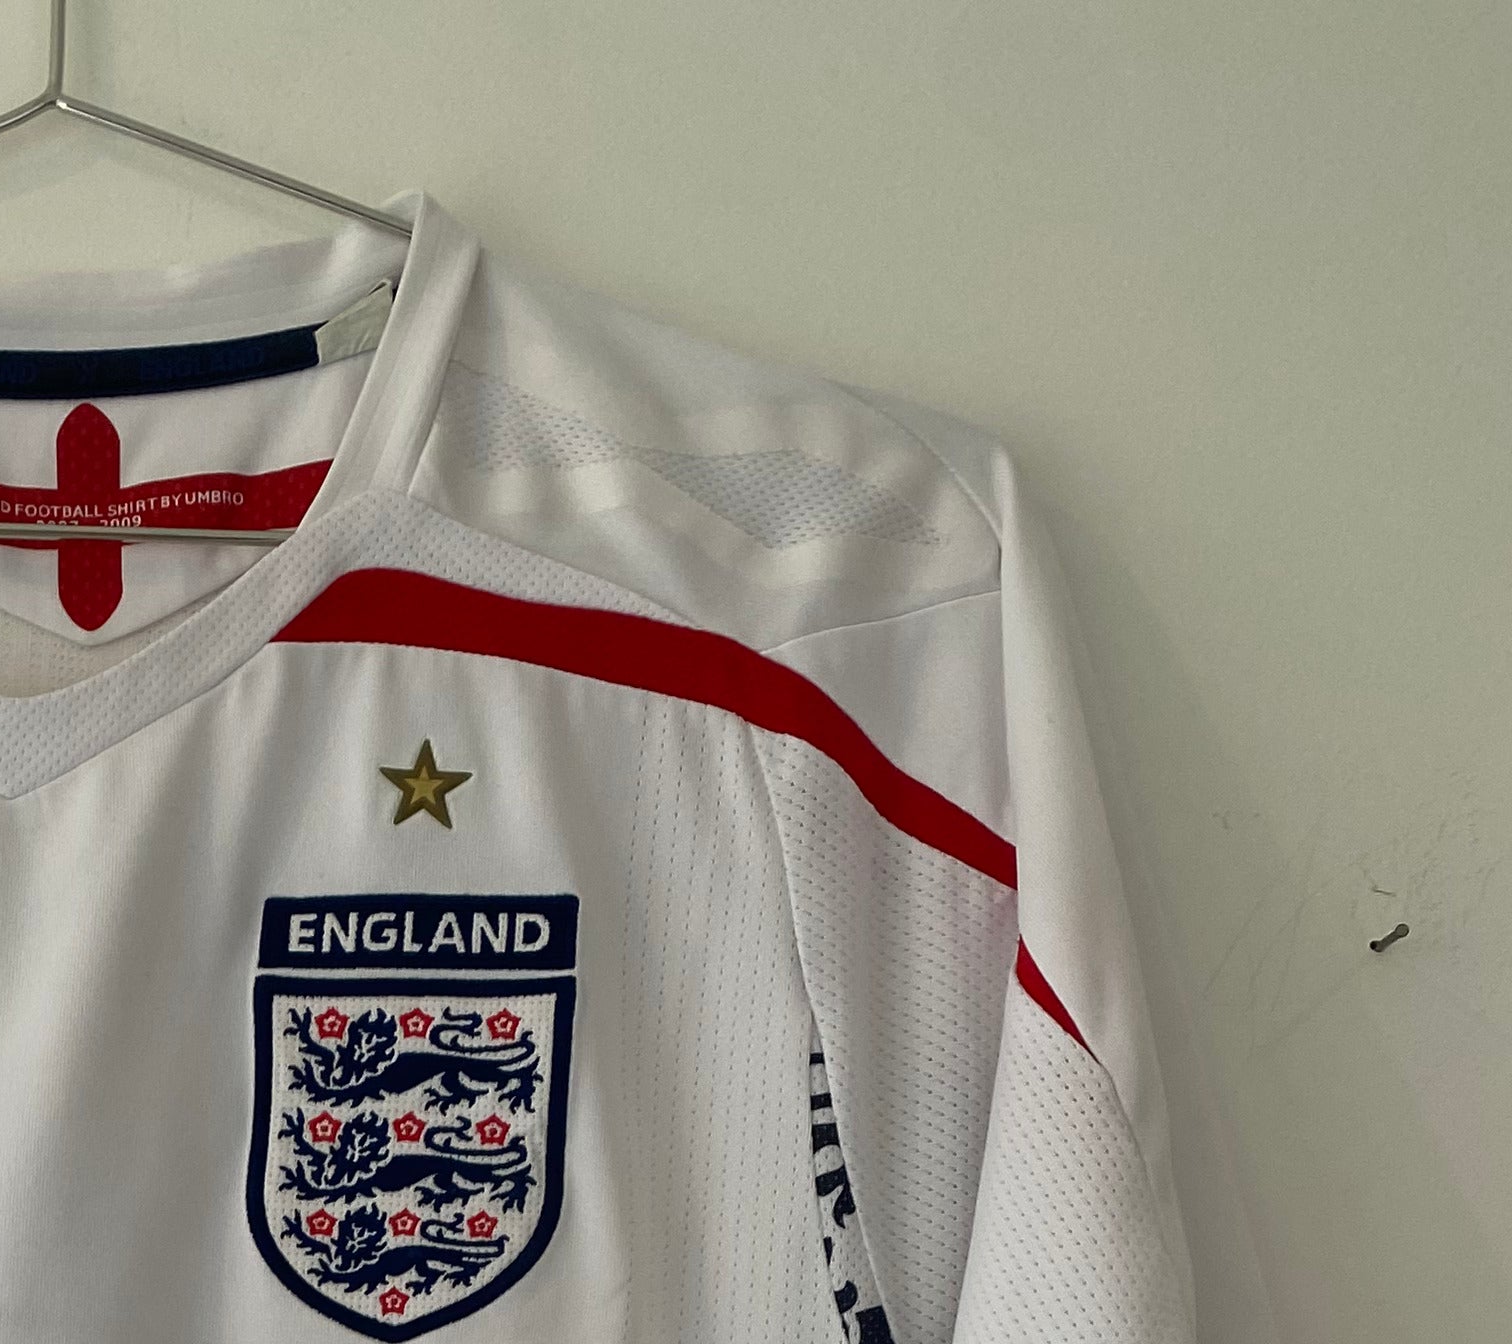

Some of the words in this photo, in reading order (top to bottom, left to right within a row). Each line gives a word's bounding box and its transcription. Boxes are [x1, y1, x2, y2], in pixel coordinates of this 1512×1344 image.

[14, 503, 103, 518] FOOTBALL
[107, 497, 158, 517] SHIRT
[161, 493, 182, 508] BY
[184, 490, 244, 506] UMBRO
[286, 911, 552, 954] ENGLAND
